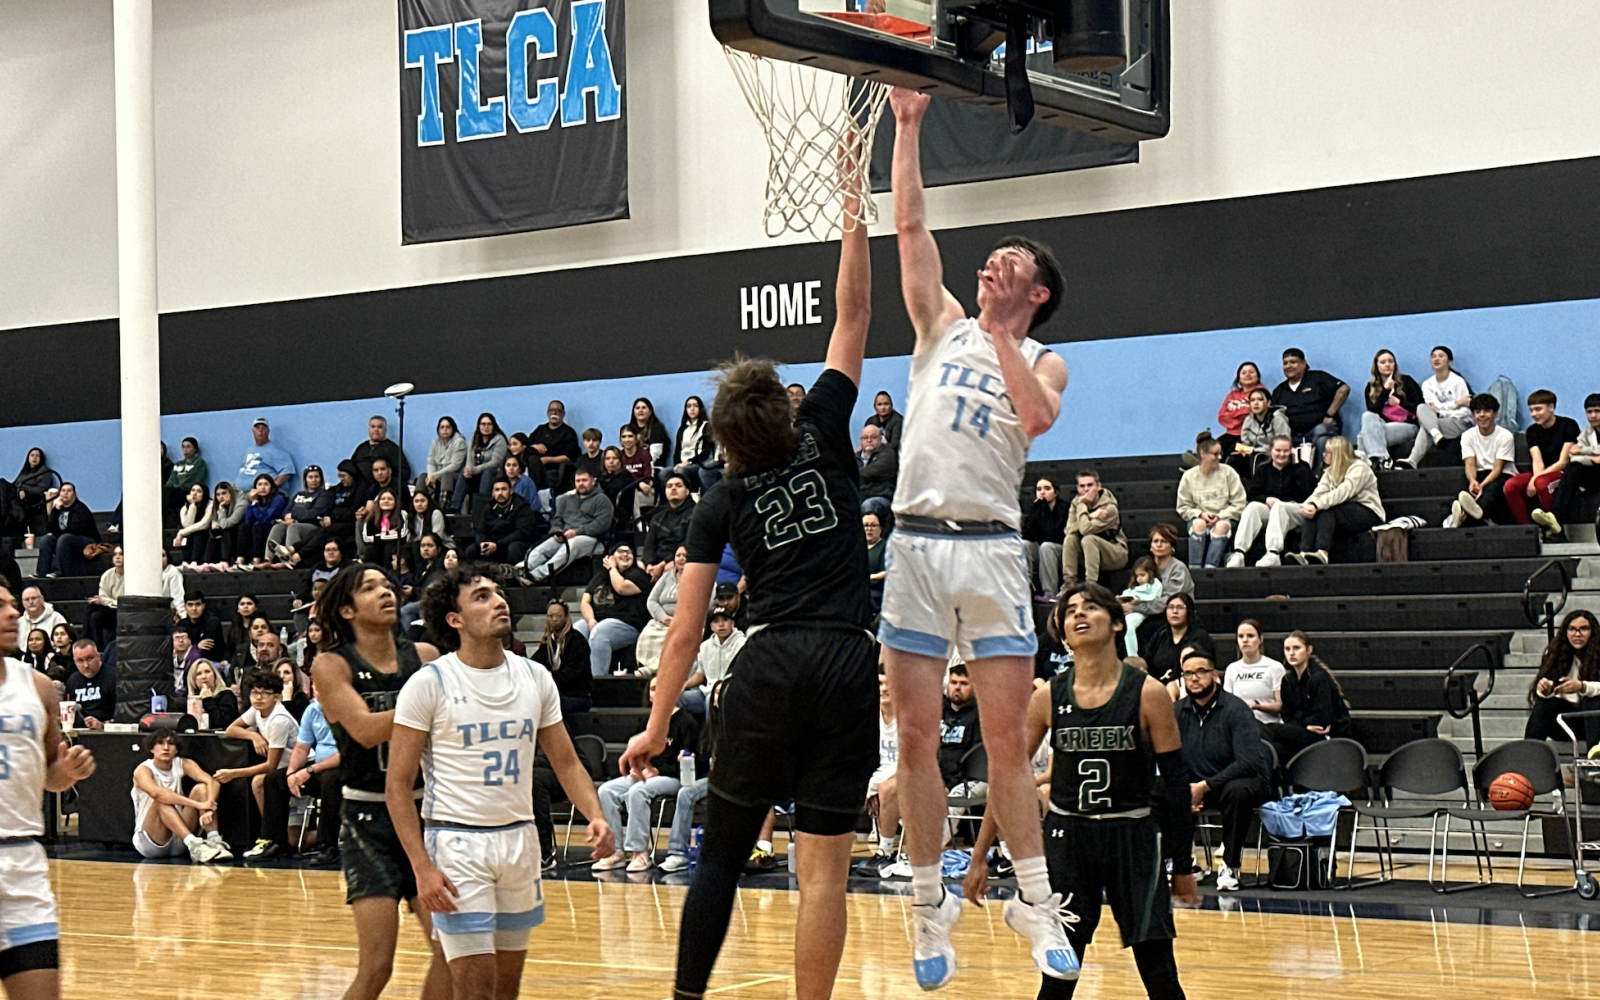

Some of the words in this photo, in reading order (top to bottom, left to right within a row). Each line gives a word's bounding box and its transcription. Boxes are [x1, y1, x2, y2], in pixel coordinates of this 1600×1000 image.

[404, 0, 621, 147] TLCA
[740, 280, 822, 330] HOME
[951, 396, 993, 439] 14
[754, 469, 839, 550] 23
[1236, 671, 1265, 681] NIKE
[457, 718, 534, 749] TLCA
[1056, 725, 1137, 752] CREEK
[483, 749, 520, 786] 24
[1078, 758, 1112, 811] 2
